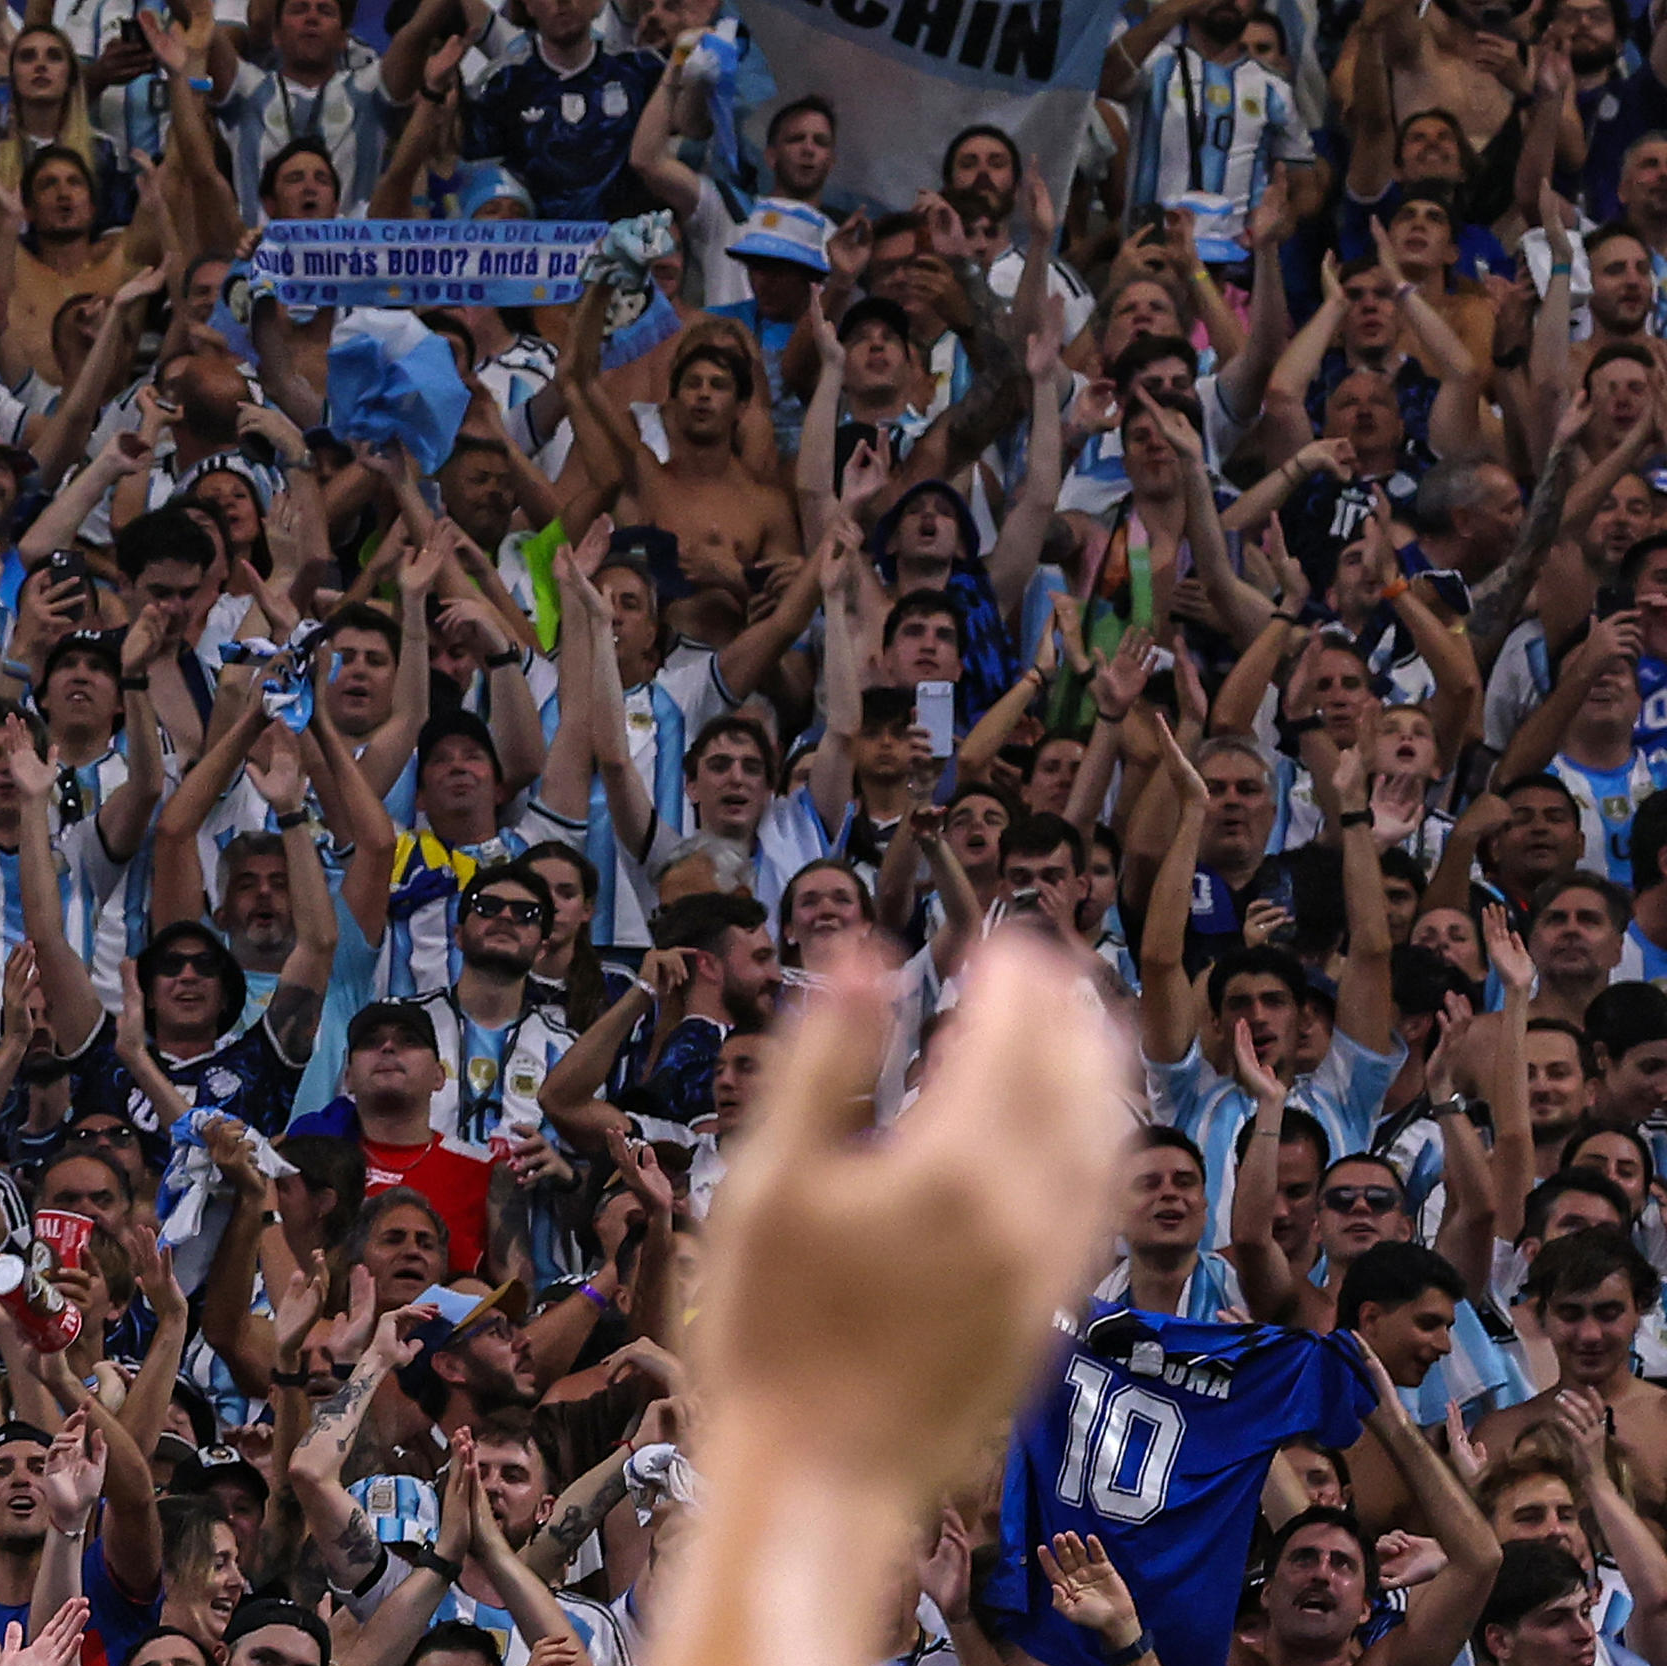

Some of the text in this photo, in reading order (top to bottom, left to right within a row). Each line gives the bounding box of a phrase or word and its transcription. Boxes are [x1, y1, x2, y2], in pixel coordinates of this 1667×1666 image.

[505, 225, 544, 242] DEL
[303, 246, 378, 276] mirás
[387, 248, 469, 277] BOBO?
[478, 247, 539, 276] Andá
[1058, 1353, 1186, 1524] 10
